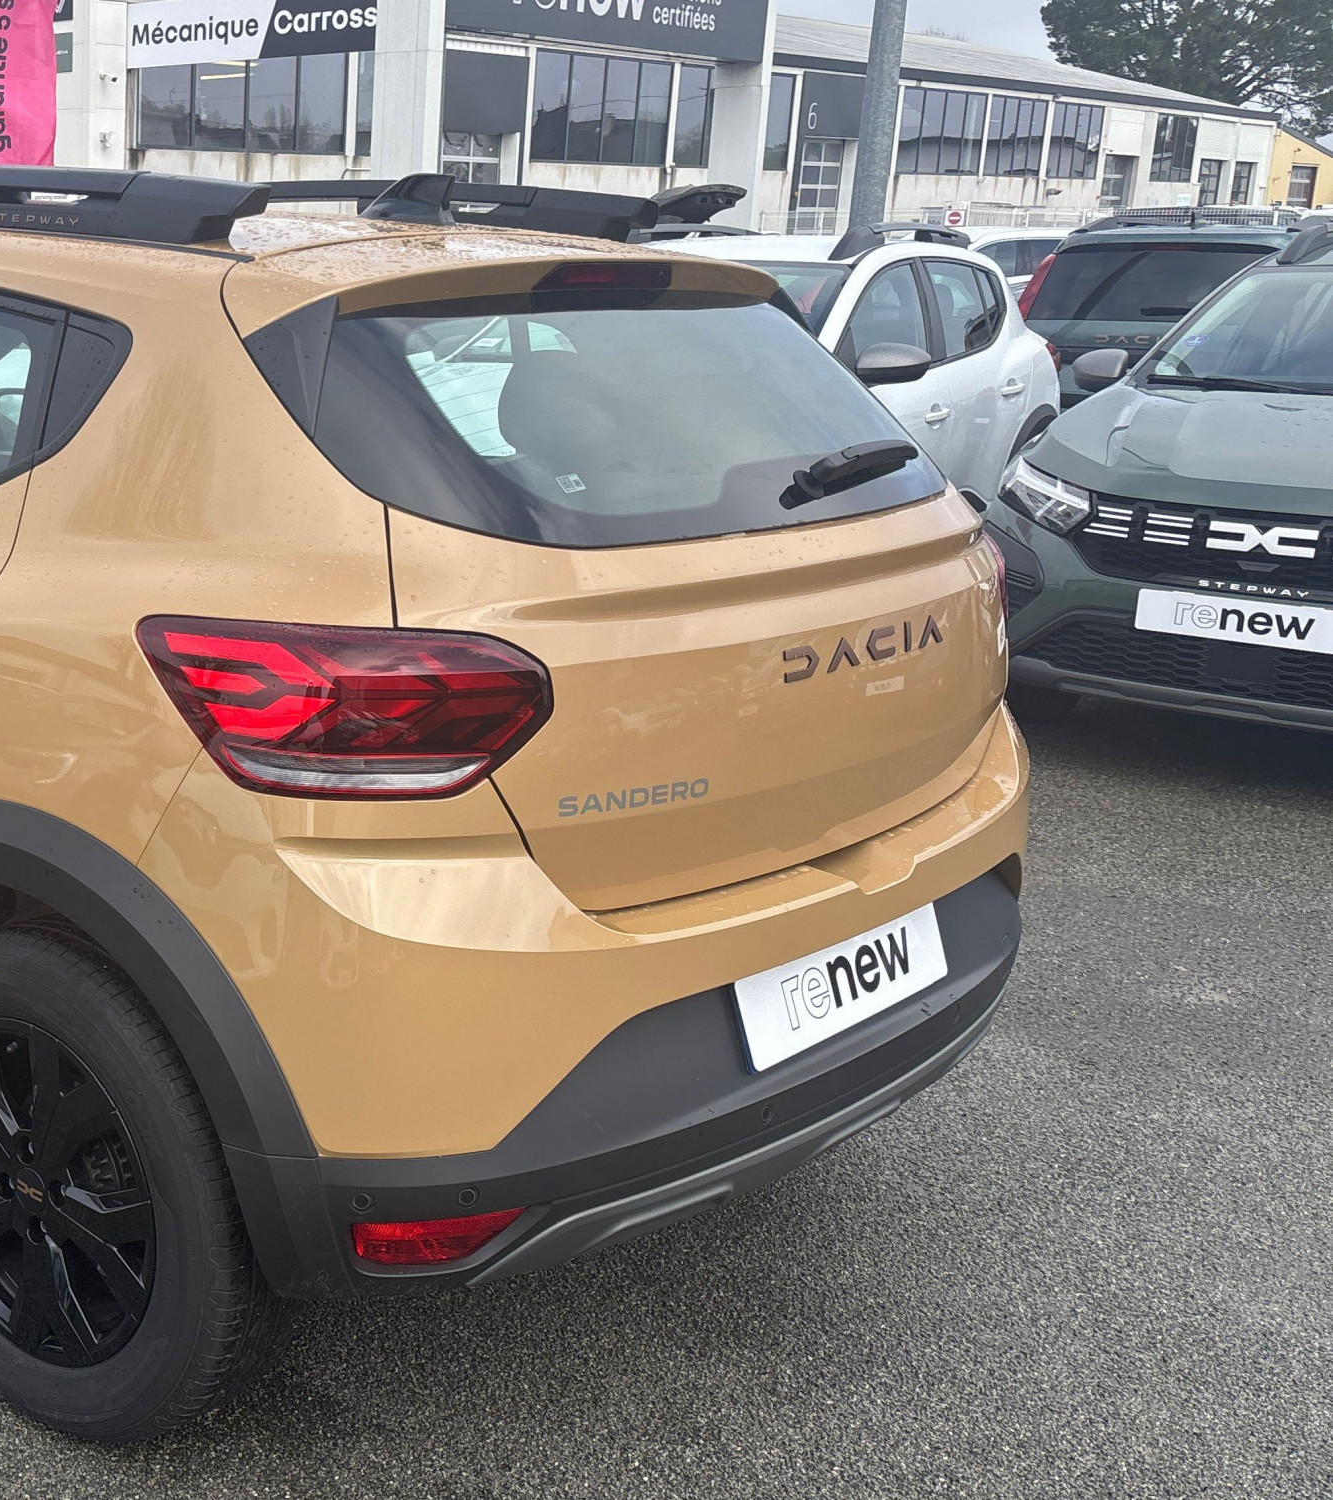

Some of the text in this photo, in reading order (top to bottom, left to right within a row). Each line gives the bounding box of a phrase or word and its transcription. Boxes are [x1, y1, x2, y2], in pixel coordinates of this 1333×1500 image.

[131, 15, 260, 46] Mécanique
[273, 6, 378, 35] Carross
[652, 3, 716, 32] certifiées
[808, 101, 818, 131] 6
[1198, 578, 1310, 599] STEPWAY
[1173, 601, 1317, 641] renew
[782, 614, 944, 684] DACIA
[557, 777, 710, 818] SANDERO
[779, 925, 911, 1031] renew
